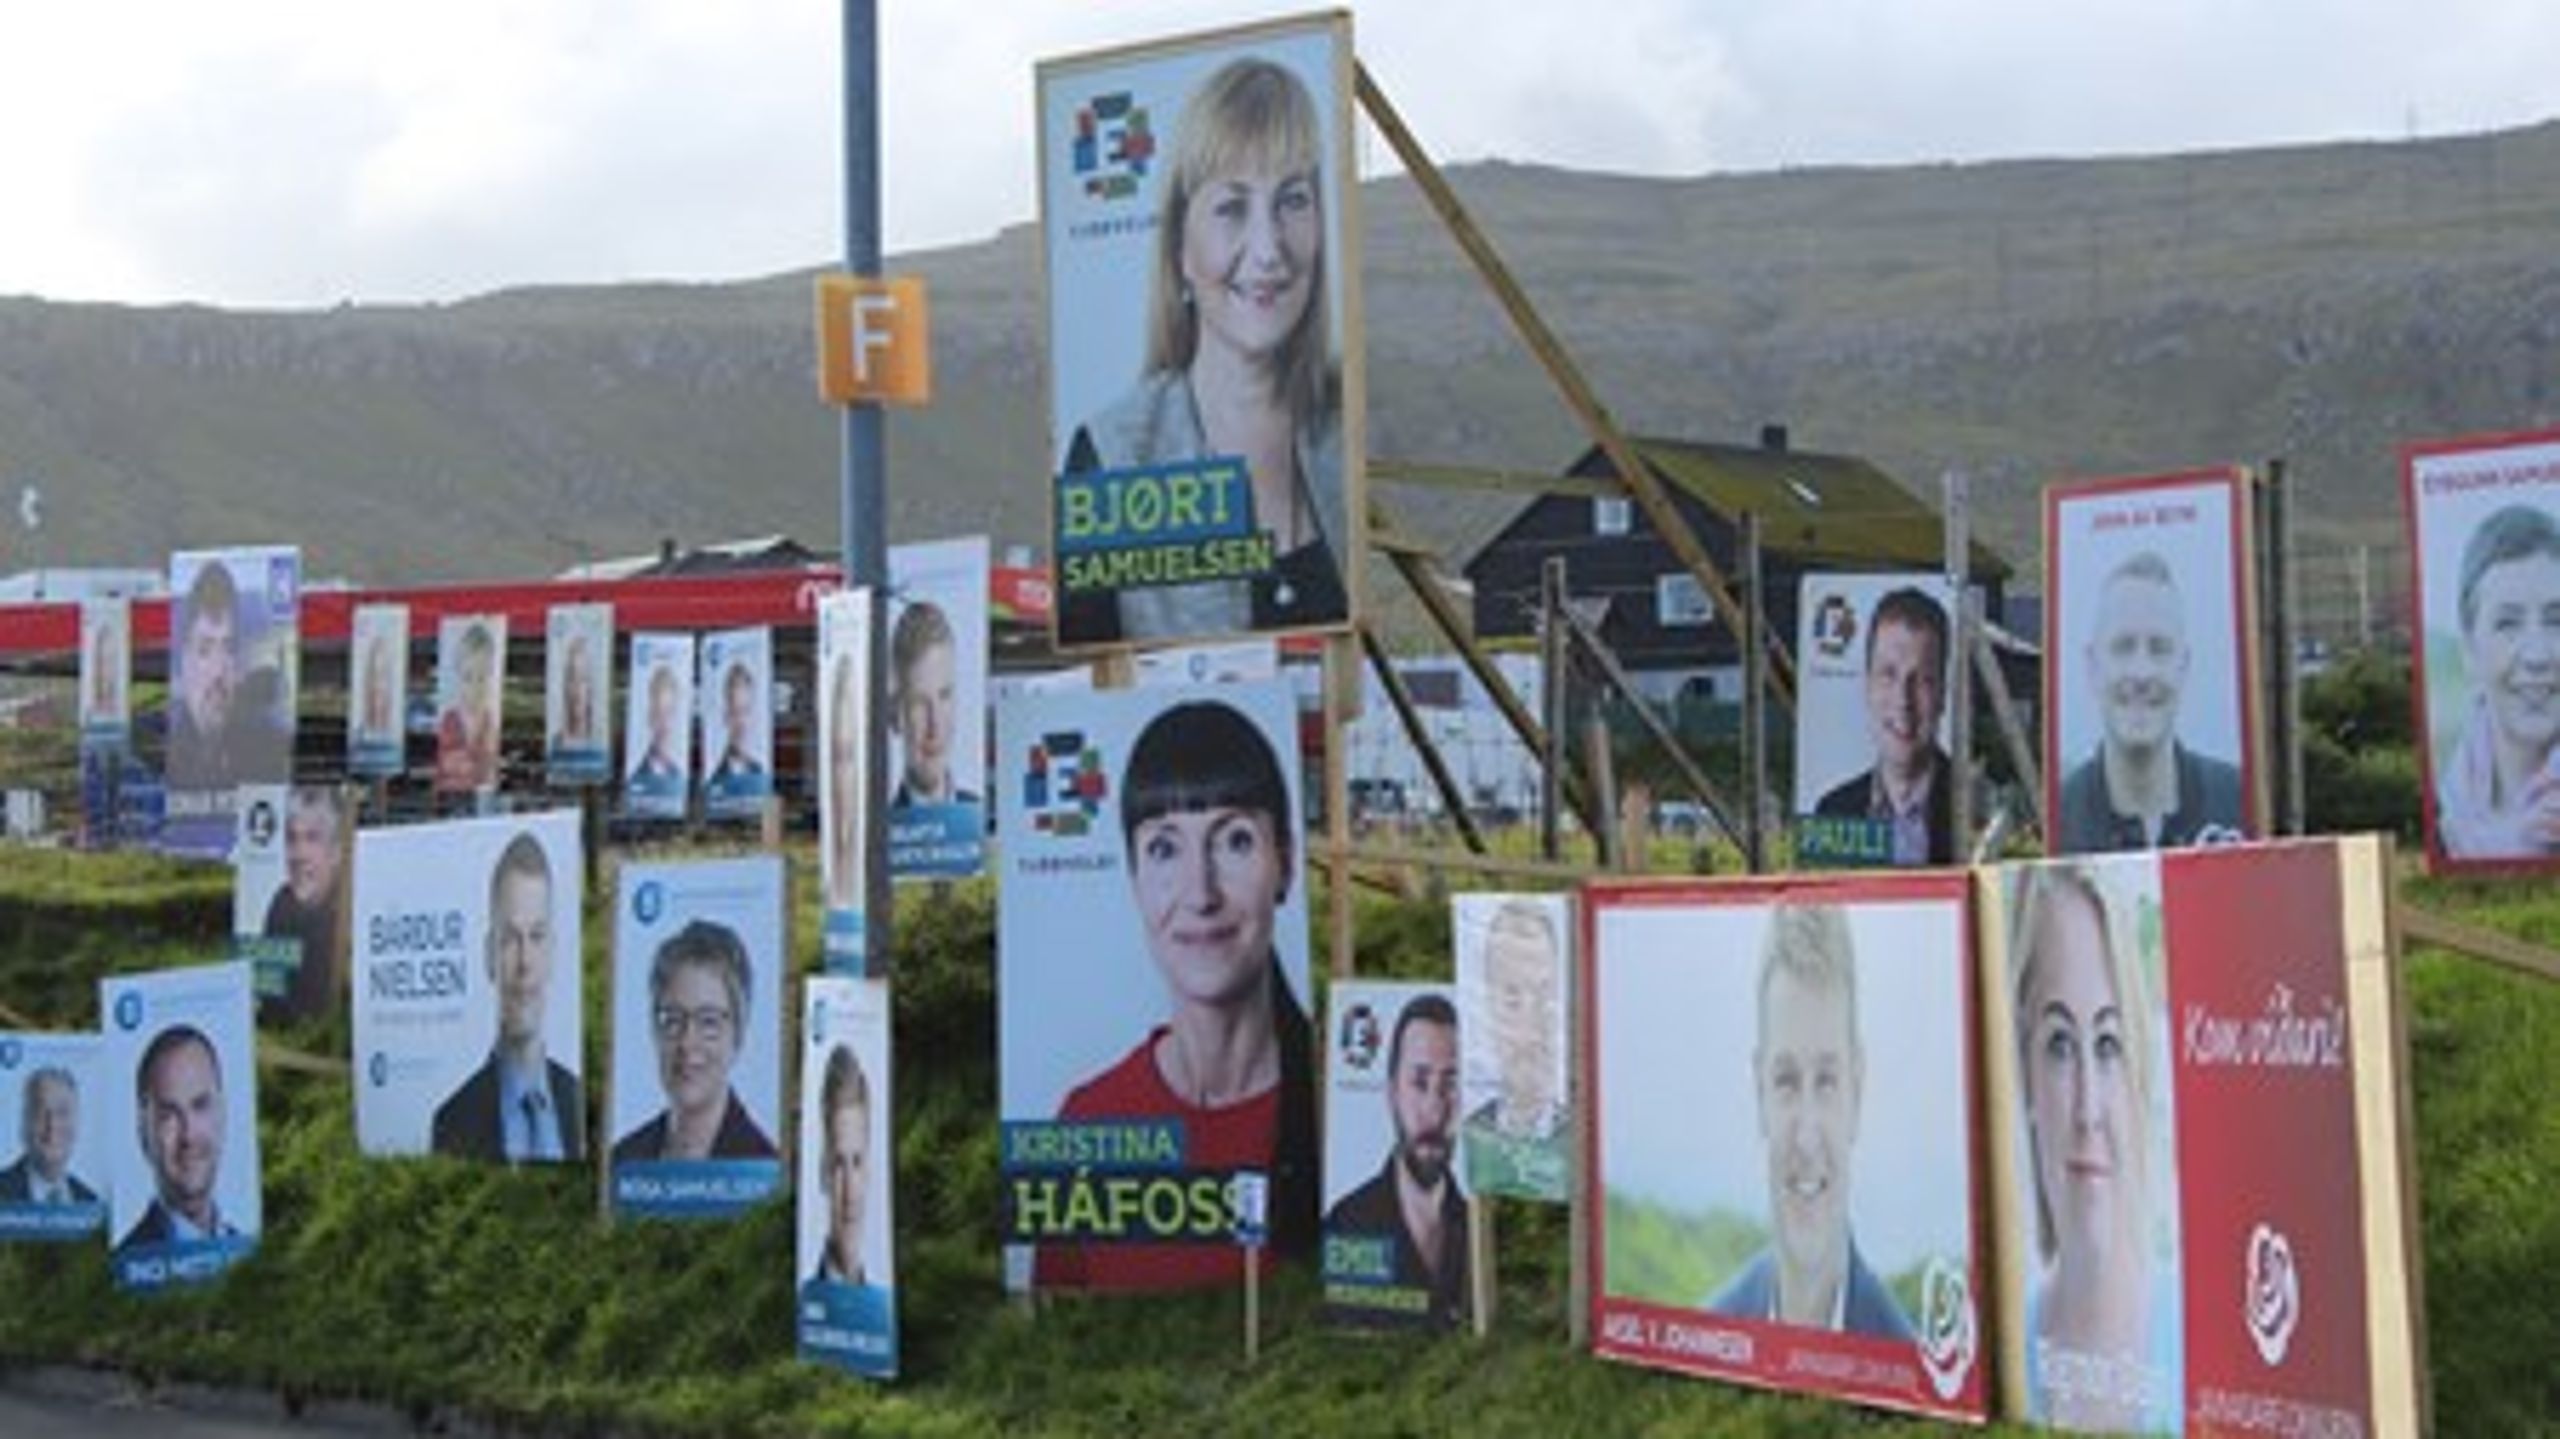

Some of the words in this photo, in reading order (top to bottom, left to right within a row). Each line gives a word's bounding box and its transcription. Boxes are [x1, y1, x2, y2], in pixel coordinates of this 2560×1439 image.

[852, 295, 896, 383] F
[1064, 467, 1236, 537] BJØRT
[1064, 535, 1272, 590] SAMUELSEN
[370, 957, 467, 999] NIELSEN
[1012, 1122, 1179, 1162] KRISTINA
